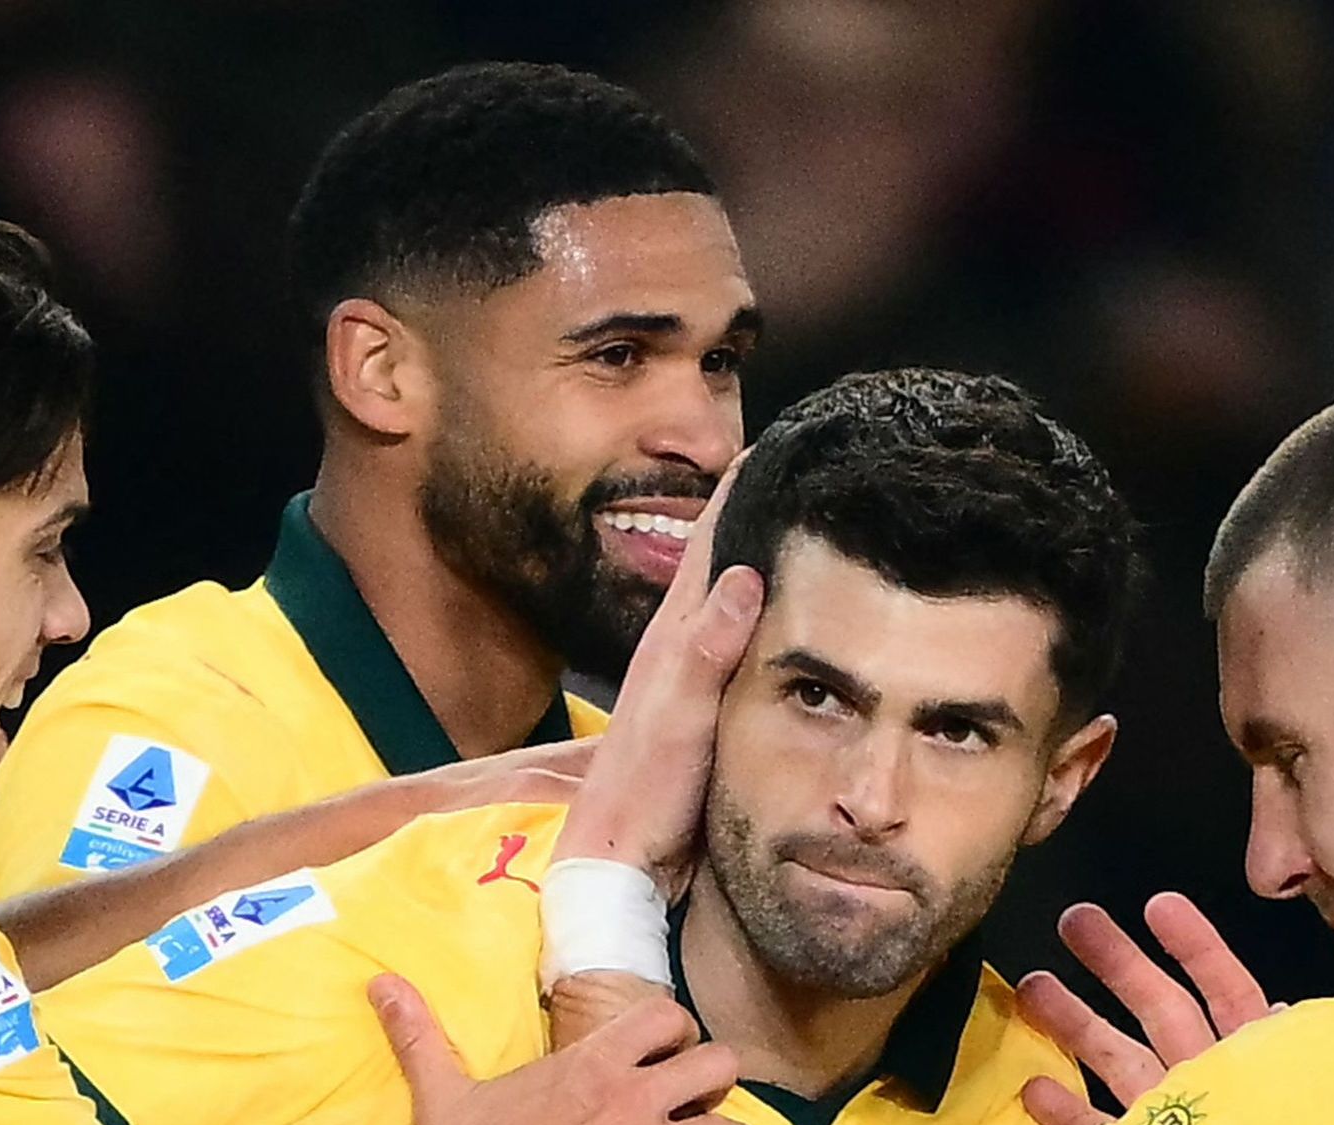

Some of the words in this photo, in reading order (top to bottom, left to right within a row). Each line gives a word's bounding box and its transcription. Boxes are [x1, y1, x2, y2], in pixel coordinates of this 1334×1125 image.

[92, 806, 149, 832] SERIE
[151, 822, 165, 838] A
[204, 905, 233, 932] SERIE
[219, 931, 237, 945] A
[1, 974, 14, 990] A
